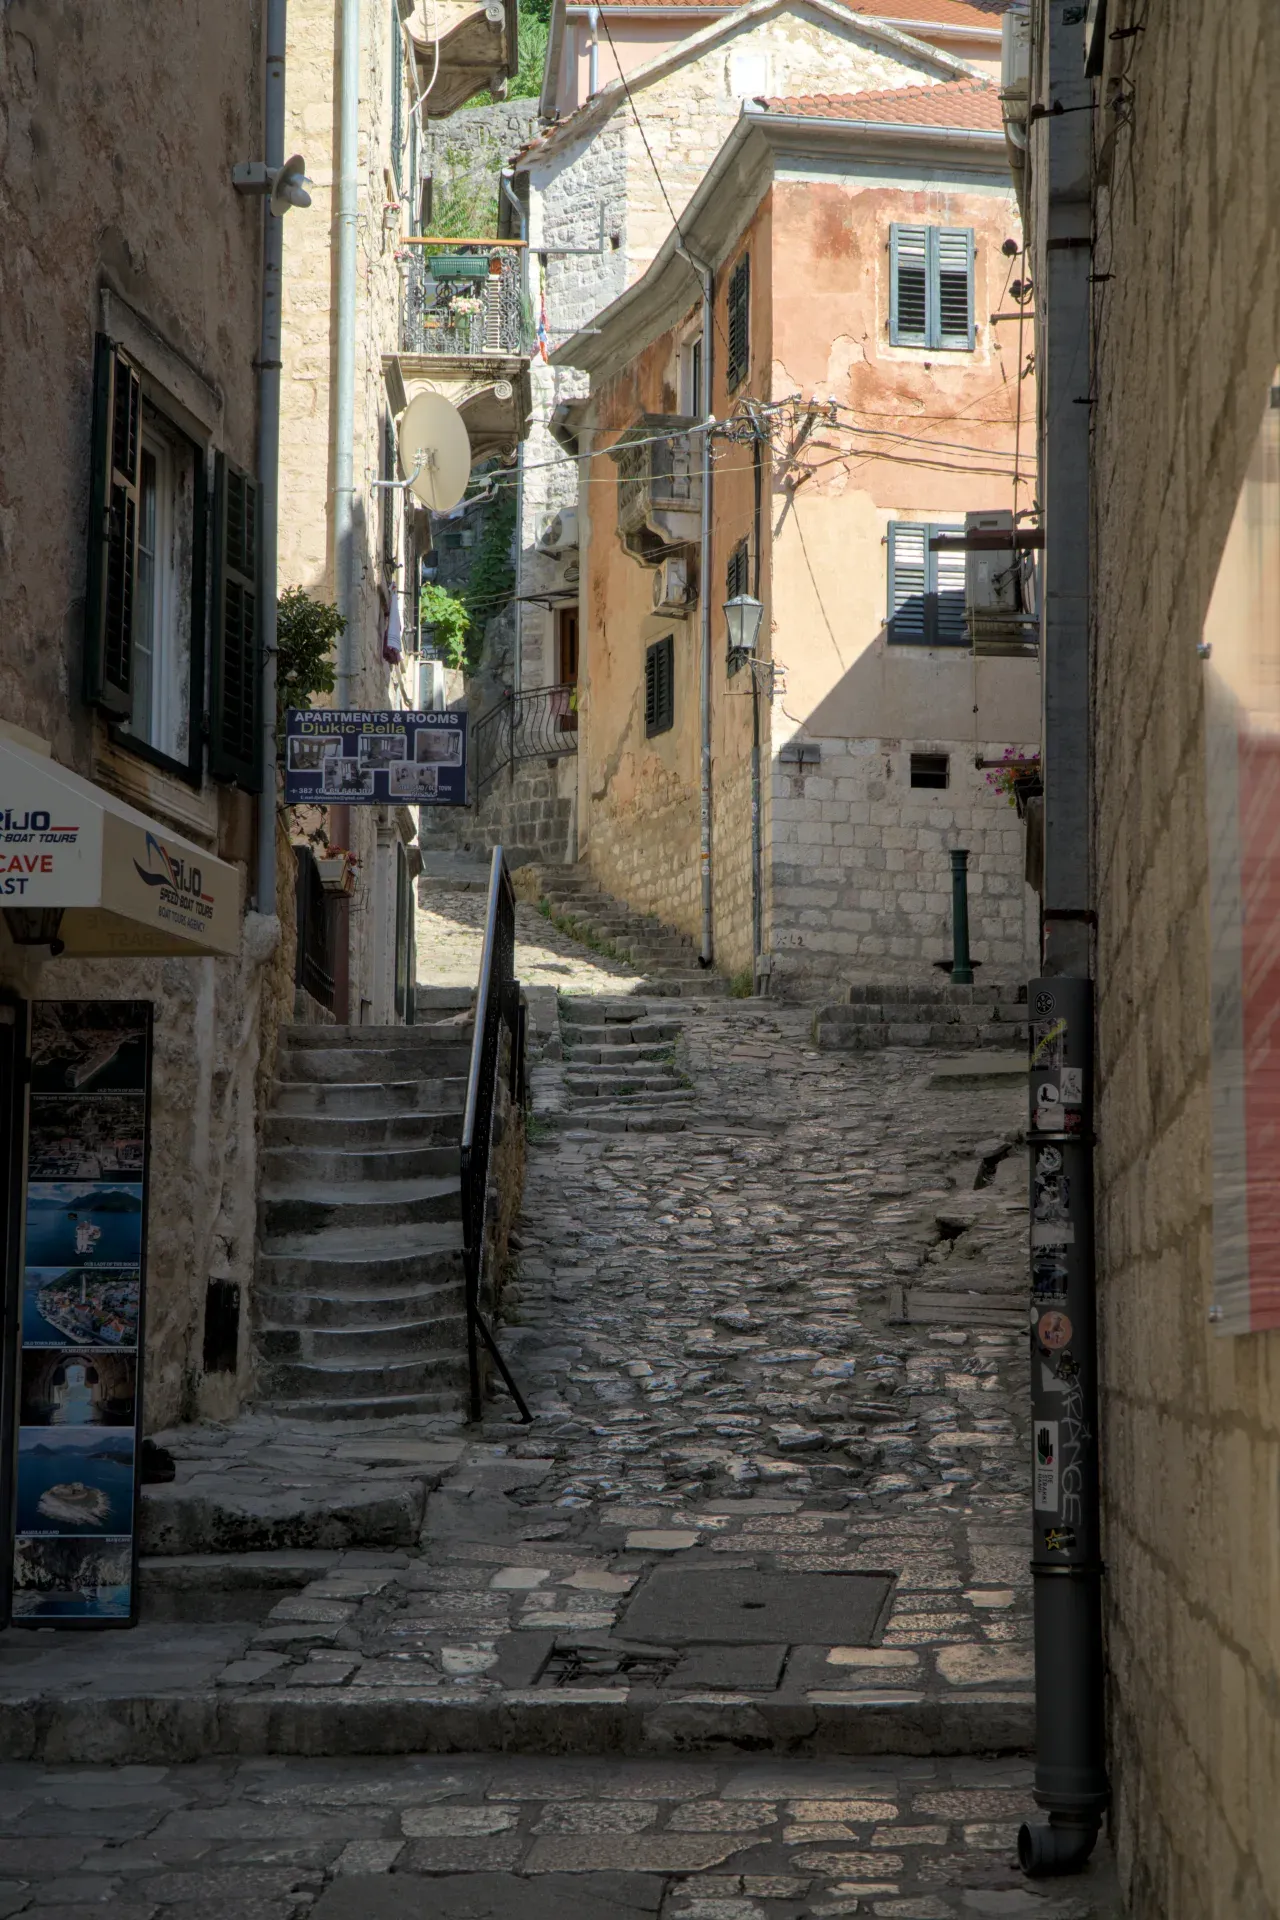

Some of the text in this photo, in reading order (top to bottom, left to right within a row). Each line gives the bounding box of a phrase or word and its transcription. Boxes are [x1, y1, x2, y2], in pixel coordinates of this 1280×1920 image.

[294, 712, 459, 725] APARTMENTS & ROOMS
[300, 722, 406, 736] Djukic-Bella
[4, 833, 78, 843] BOAT TOURS
[159, 887, 214, 919] SPEED BOAT TOURS
[158, 905, 172, 919] BOAT
[186, 916, 206, 933] AGENCY
